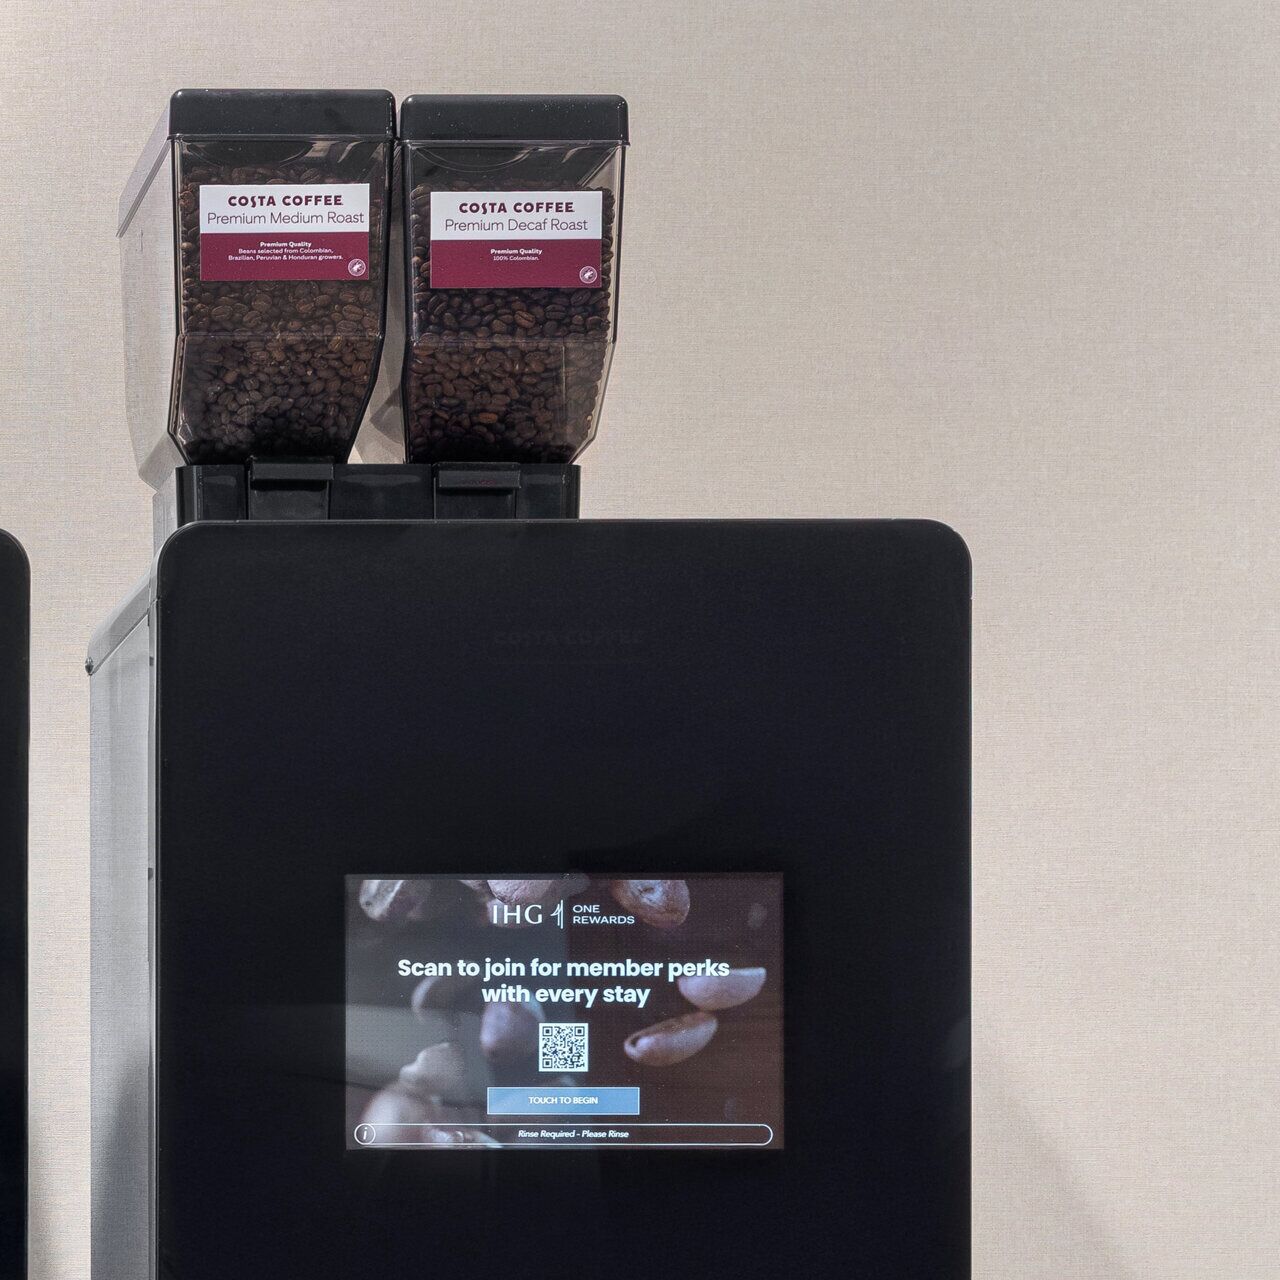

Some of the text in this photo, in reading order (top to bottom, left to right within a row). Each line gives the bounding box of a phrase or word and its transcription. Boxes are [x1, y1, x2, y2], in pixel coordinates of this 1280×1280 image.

[228, 195, 343, 208] COSTA COFFEE
[459, 202, 574, 214] COSTA COFFEE
[207, 211, 364, 224] Premium Medium Roast
[445, 218, 588, 231] Premium Decaf Roast
[492, 904, 543, 924] IHG
[572, 905, 600, 913] ONE
[572, 916, 635, 925] REWARDS
[398, 958, 730, 981] Scan to join for member perks
[482, 984, 651, 1008] with every stay
[518, 1130, 629, 1139] Rinse Required Please Rinse
